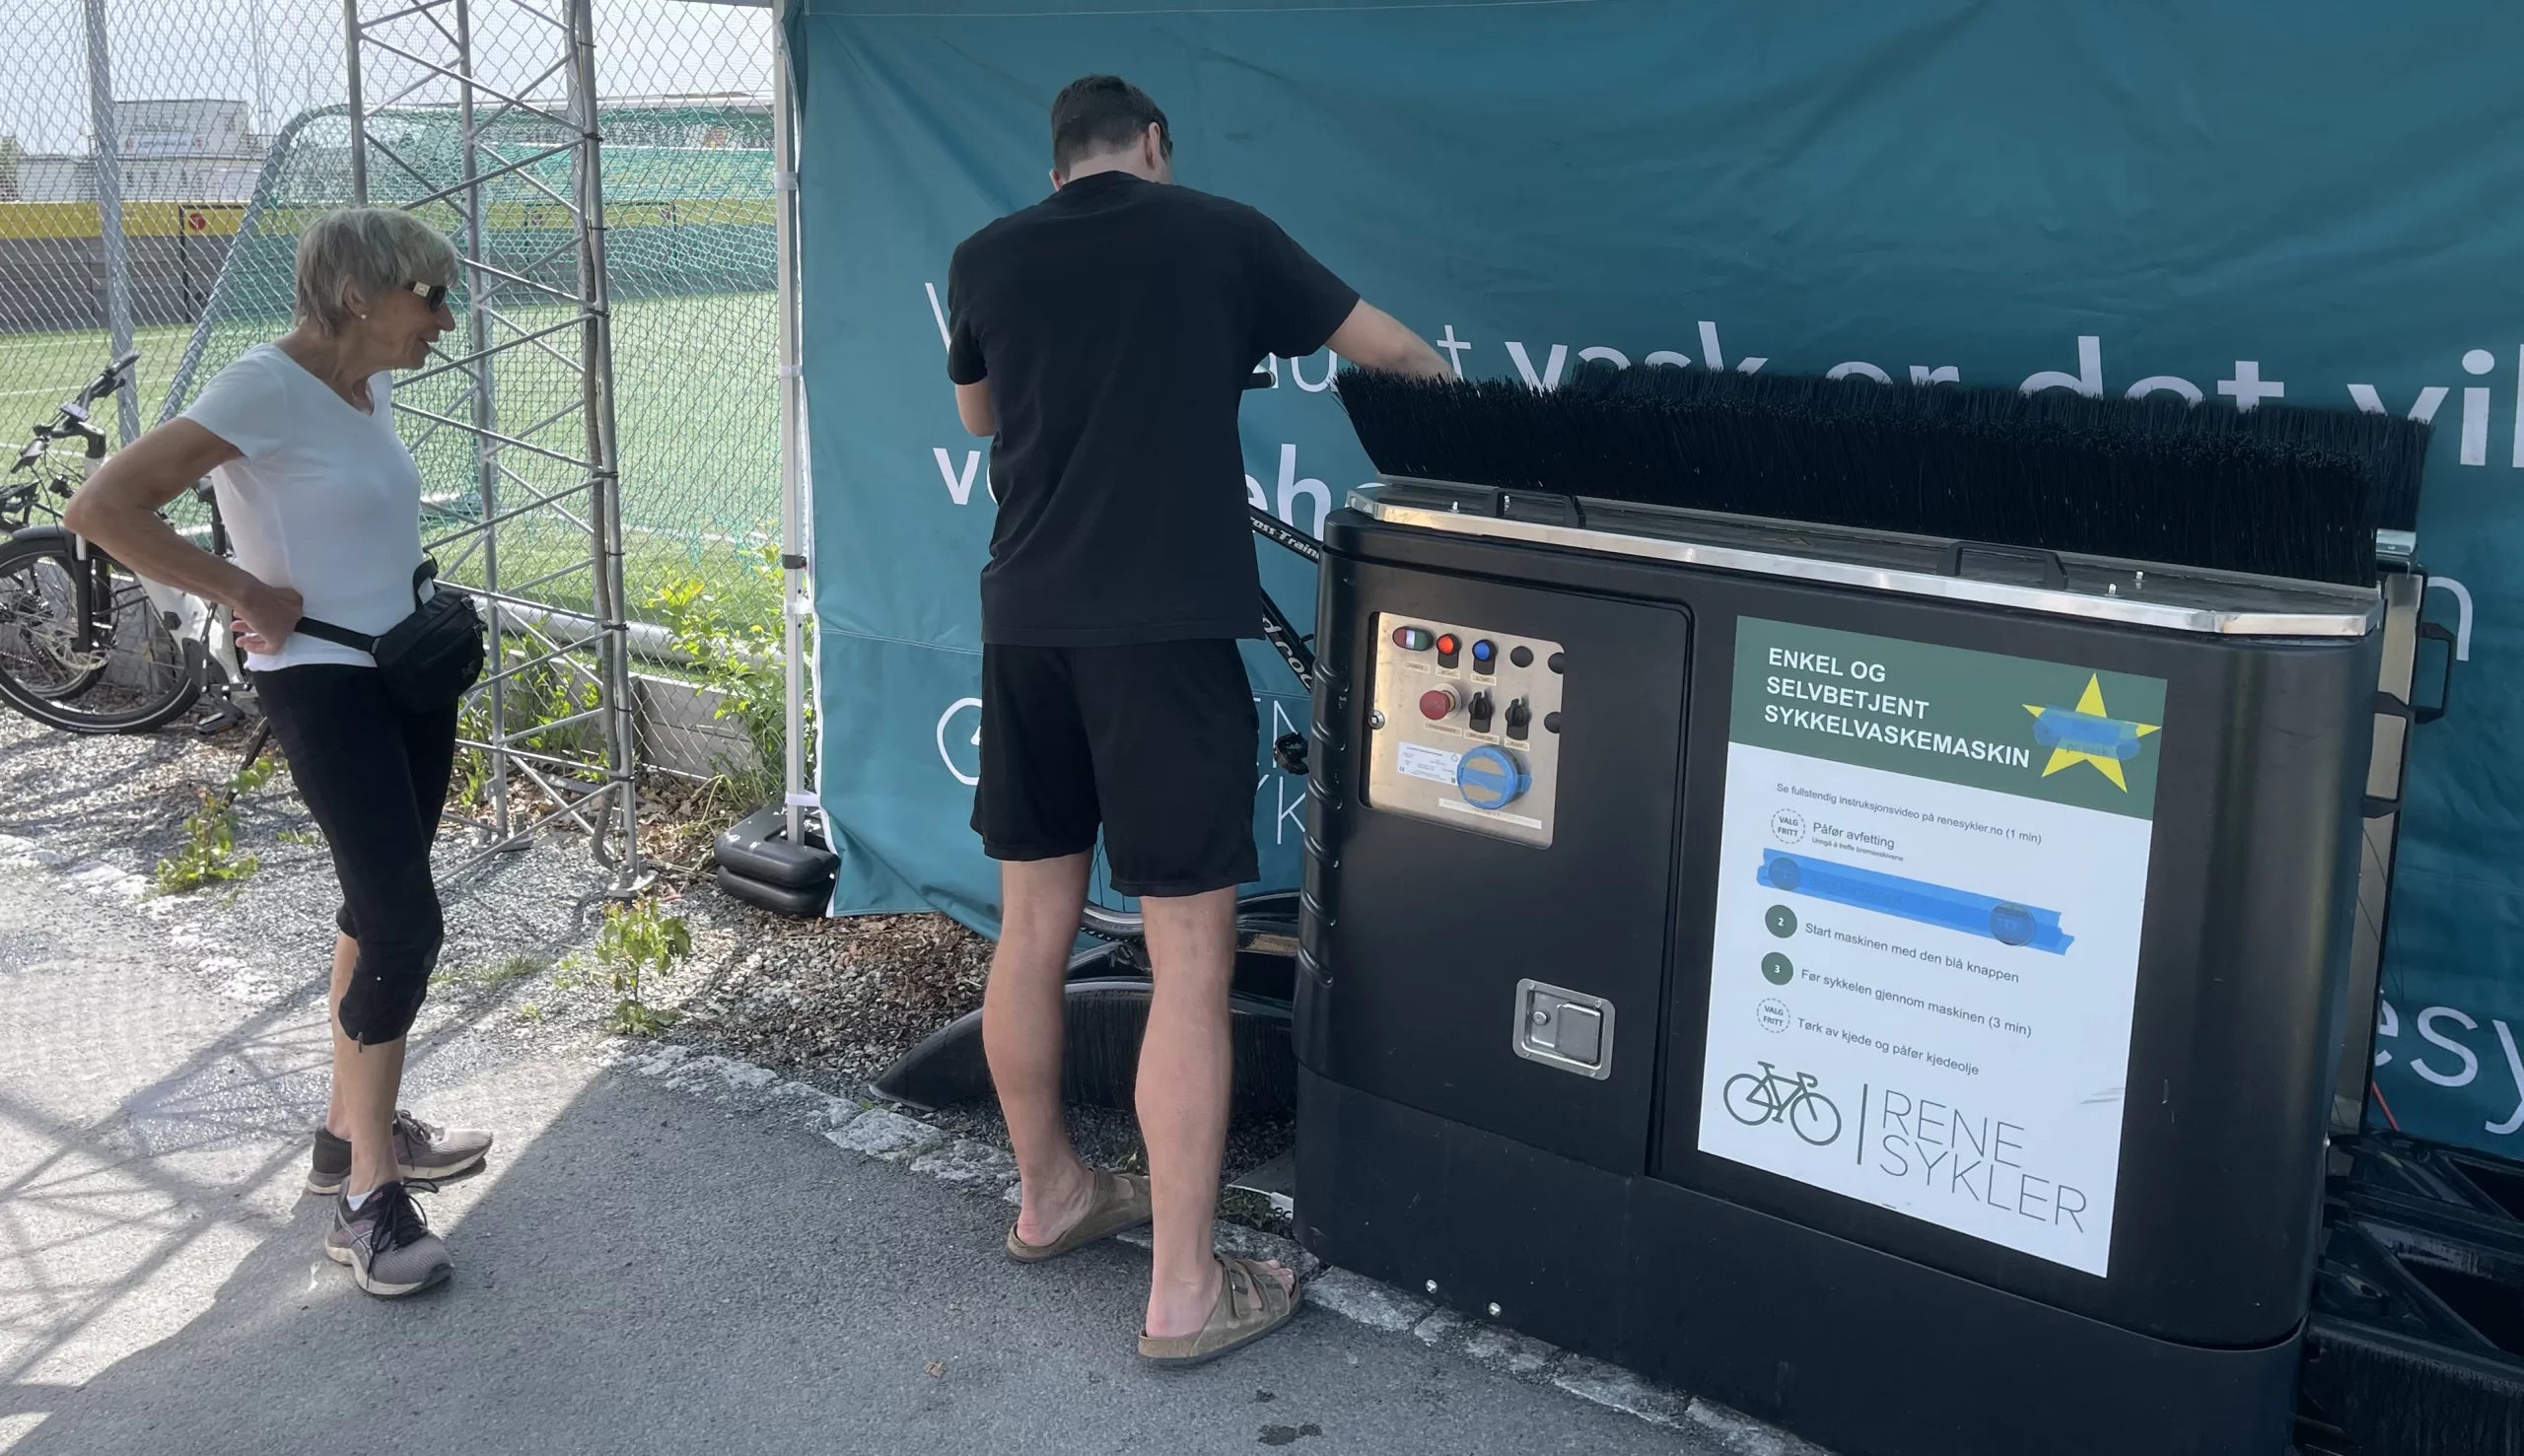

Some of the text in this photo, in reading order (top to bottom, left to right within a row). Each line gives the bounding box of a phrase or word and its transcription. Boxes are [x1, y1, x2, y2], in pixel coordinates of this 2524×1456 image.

[1768, 647, 1886, 683] ENKEL OG
[1766, 676, 1929, 720] SELVBETJENT
[1764, 704, 2030, 768] SYKKELVASKEMASKIN
[1777, 783, 2042, 845] Se fullstendig instruksjonsvideo på renesykler.no (1 min)
[1777, 826, 1798, 838] FRITT
[1779, 815, 1799, 827] VALG
[1812, 821, 1895, 851] Påfør avfetting
[1778, 917, 1785, 927] 2
[1774, 964, 1781, 974] 3
[1805, 922, 2019, 984] Start maskinen med den blå knappen
[1763, 1015, 1784, 1027] FRITT
[1764, 1005, 1785, 1016] VALG
[1801, 968, 2032, 1038] Før sykkelen gjennom maskinen (3 min)
[1797, 1017, 1980, 1075] Tørk av kjede og påfør kjedeolje
[1882, 1088, 2025, 1168] RENE
[1879, 1134, 2086, 1234] SYKLER
